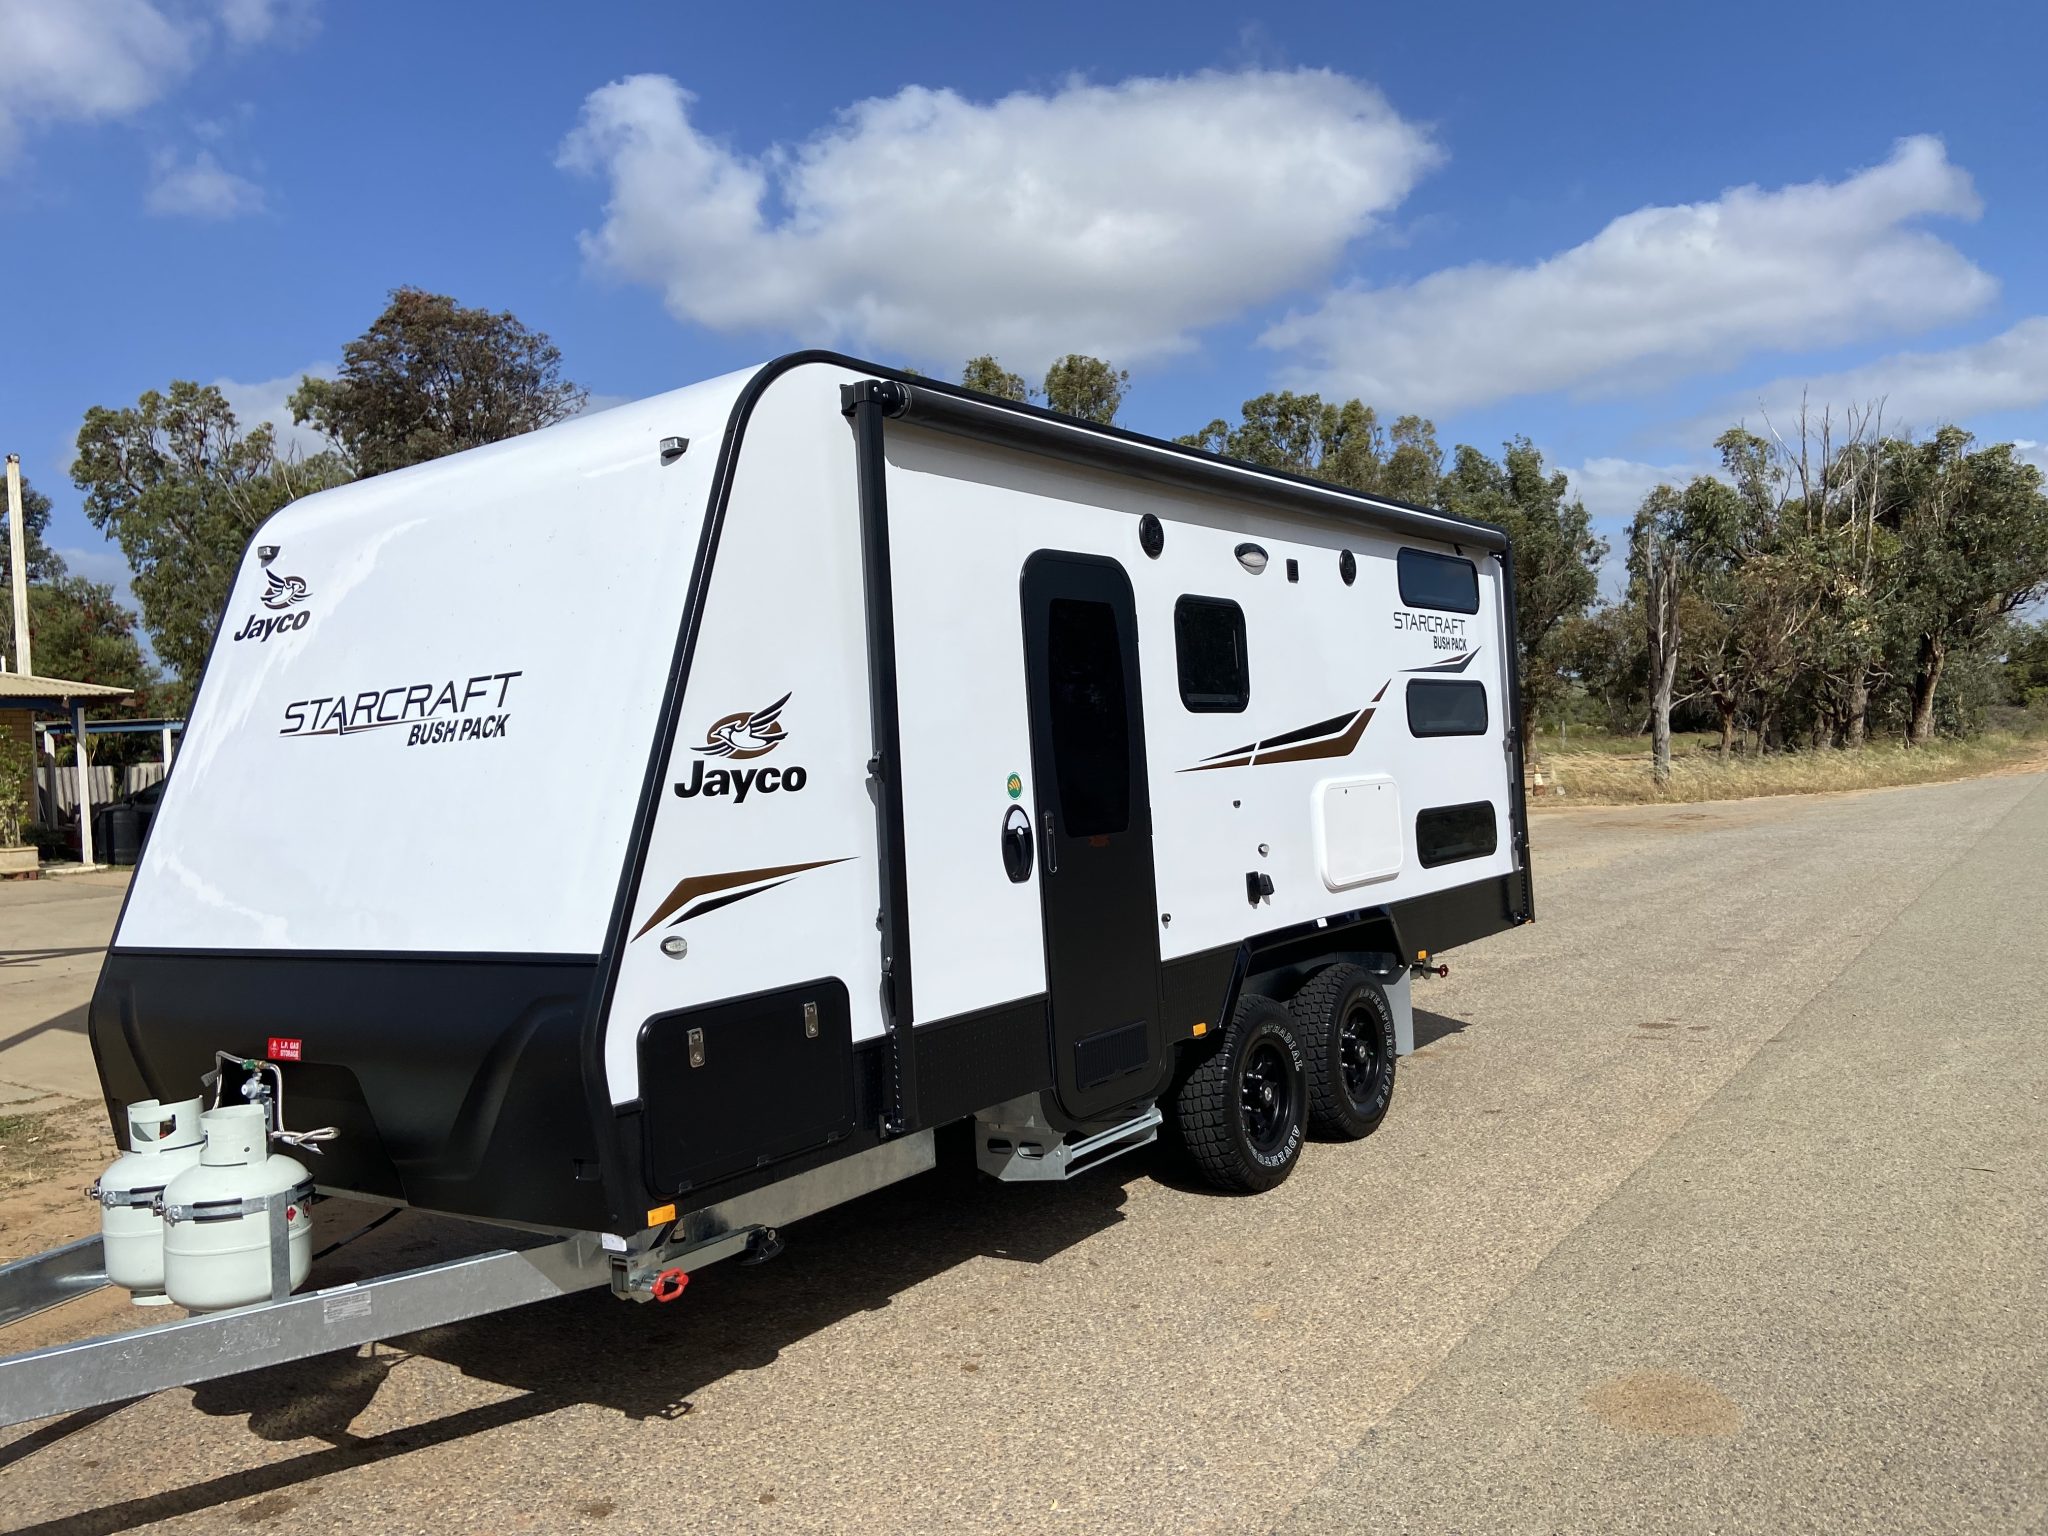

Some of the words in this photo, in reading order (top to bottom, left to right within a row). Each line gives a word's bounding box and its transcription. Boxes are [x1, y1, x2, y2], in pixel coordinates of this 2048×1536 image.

[234, 610, 311, 643] Jayco
[1393, 611, 1466, 635] STARCRAFT
[1433, 635, 1451, 651] BUSH
[1451, 637, 1467, 652] PACK
[279, 670, 523, 735] STARCRAFT
[407, 719, 459, 746] BUSH
[458, 713, 511, 741] PACK
[674, 760, 807, 804] Jayco
[1272, 1023, 1303, 1071] RADIAL
